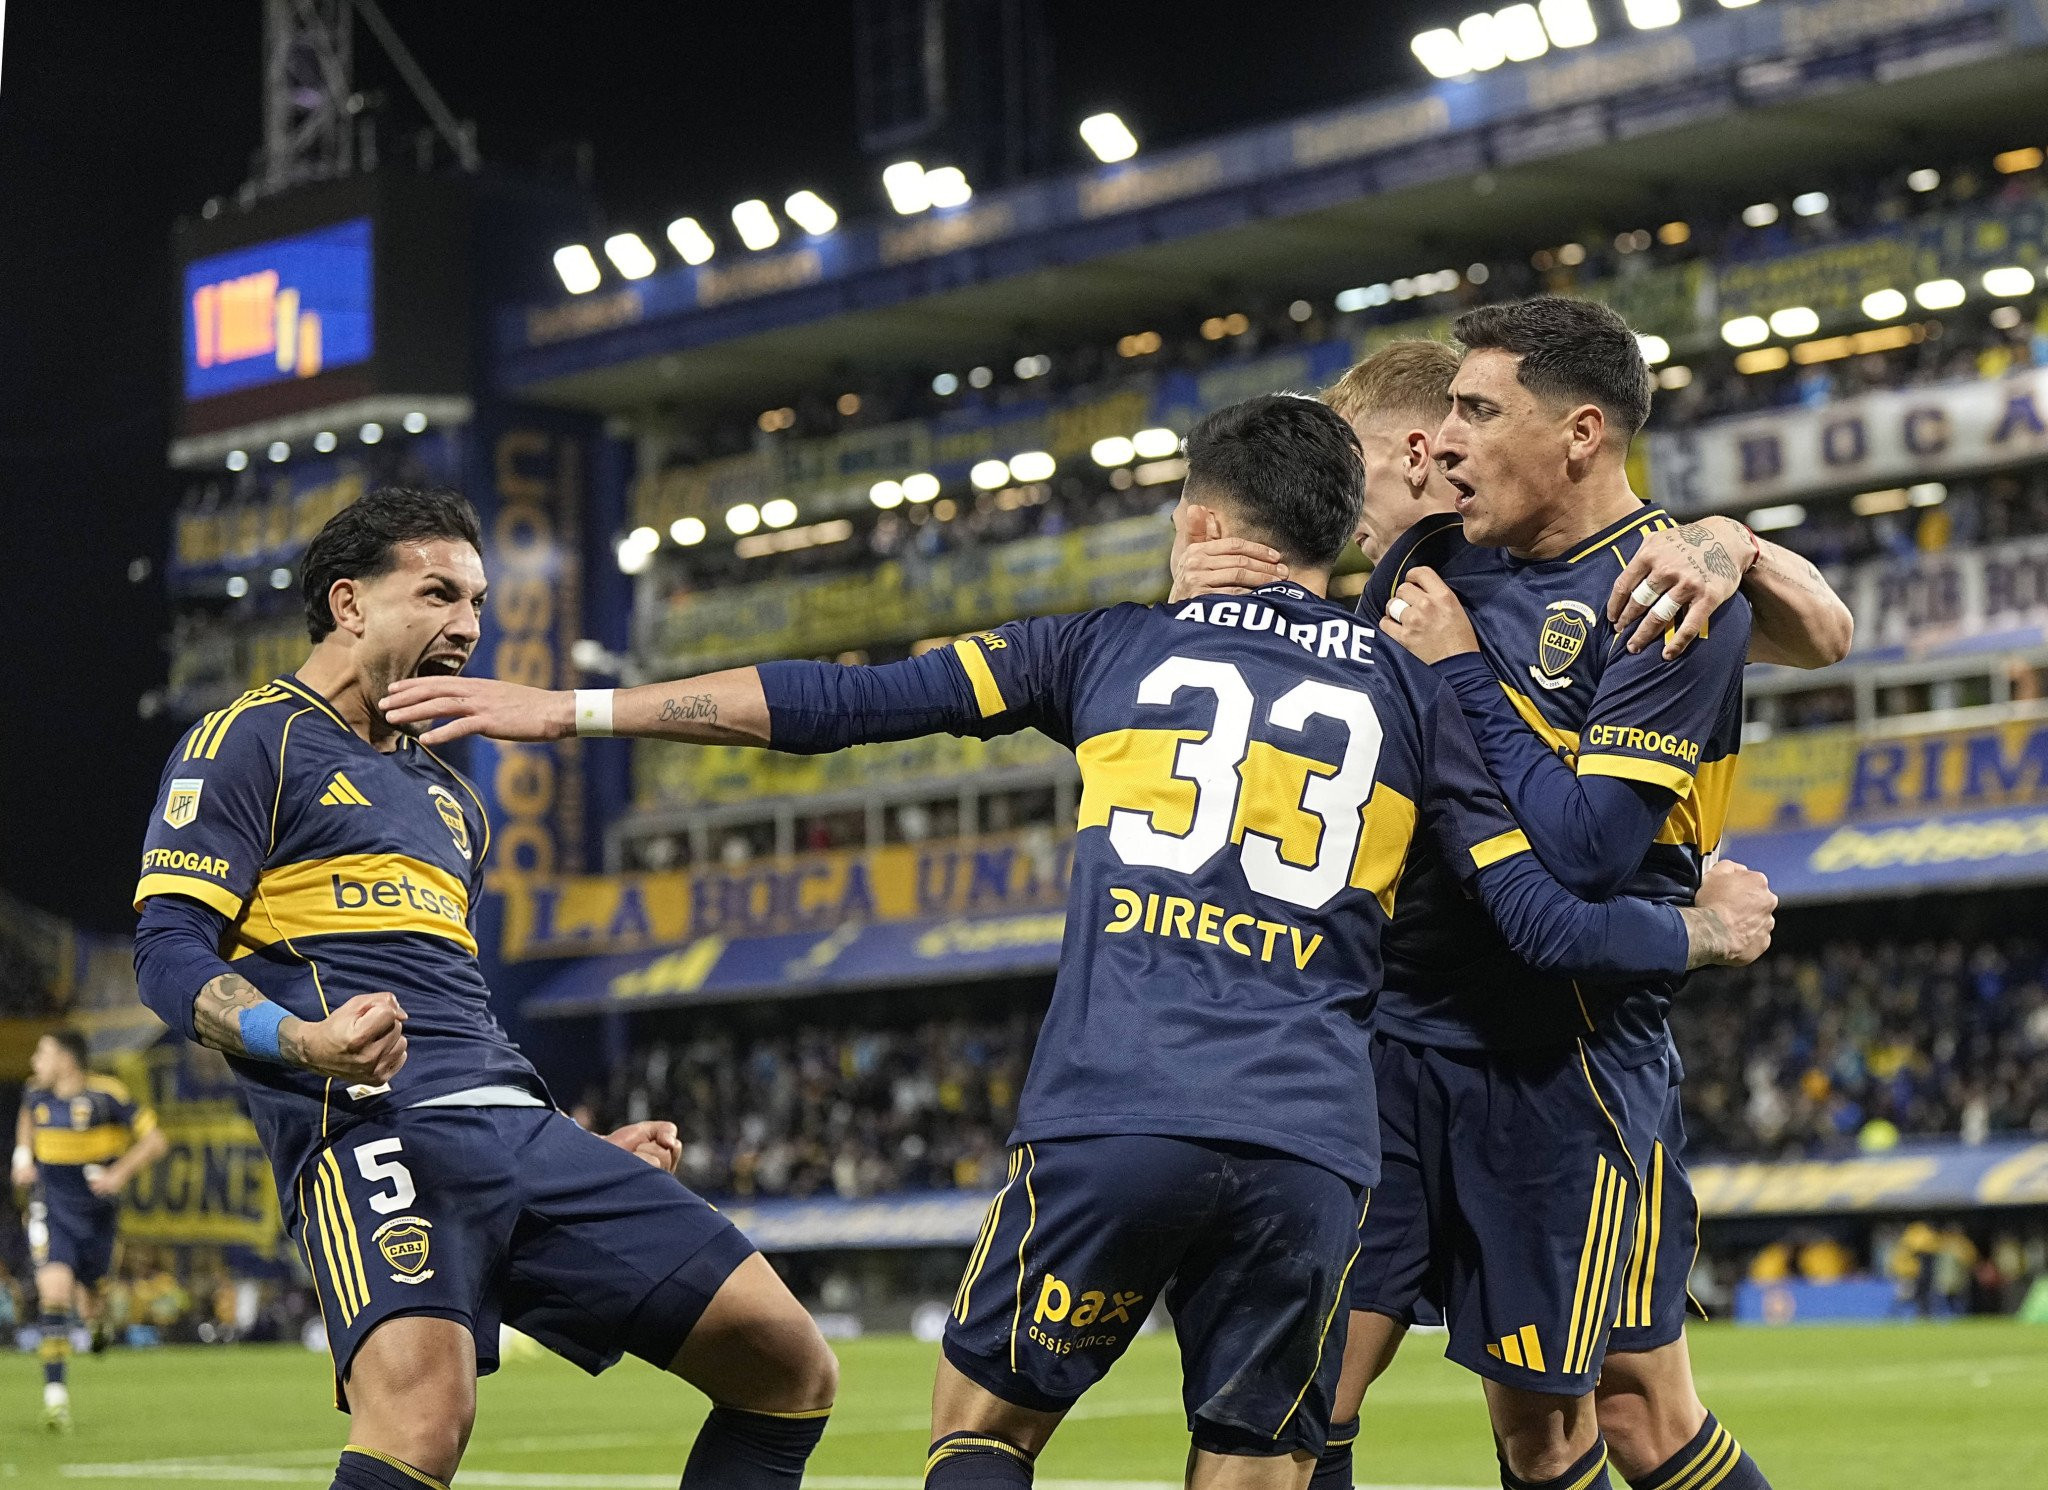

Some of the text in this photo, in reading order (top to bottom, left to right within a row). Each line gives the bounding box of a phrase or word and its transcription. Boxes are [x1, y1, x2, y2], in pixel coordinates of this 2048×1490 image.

[1174, 602, 1376, 665] AGUIRRE
[1547, 633, 1577, 651] CABJ
[657, 693, 718, 725] Beatriz
[1589, 724, 1699, 765] CETROGAR
[1108, 655, 1385, 911] 33
[143, 848, 229, 879] ETROGAR
[331, 873, 463, 927] betss
[1104, 888, 1323, 970] DIRECTV
[353, 1137, 416, 1215] 5
[389, 1243, 423, 1256] CABJ
[1034, 1273, 1143, 1327] pax
[1028, 1325, 1117, 1355] assisance
